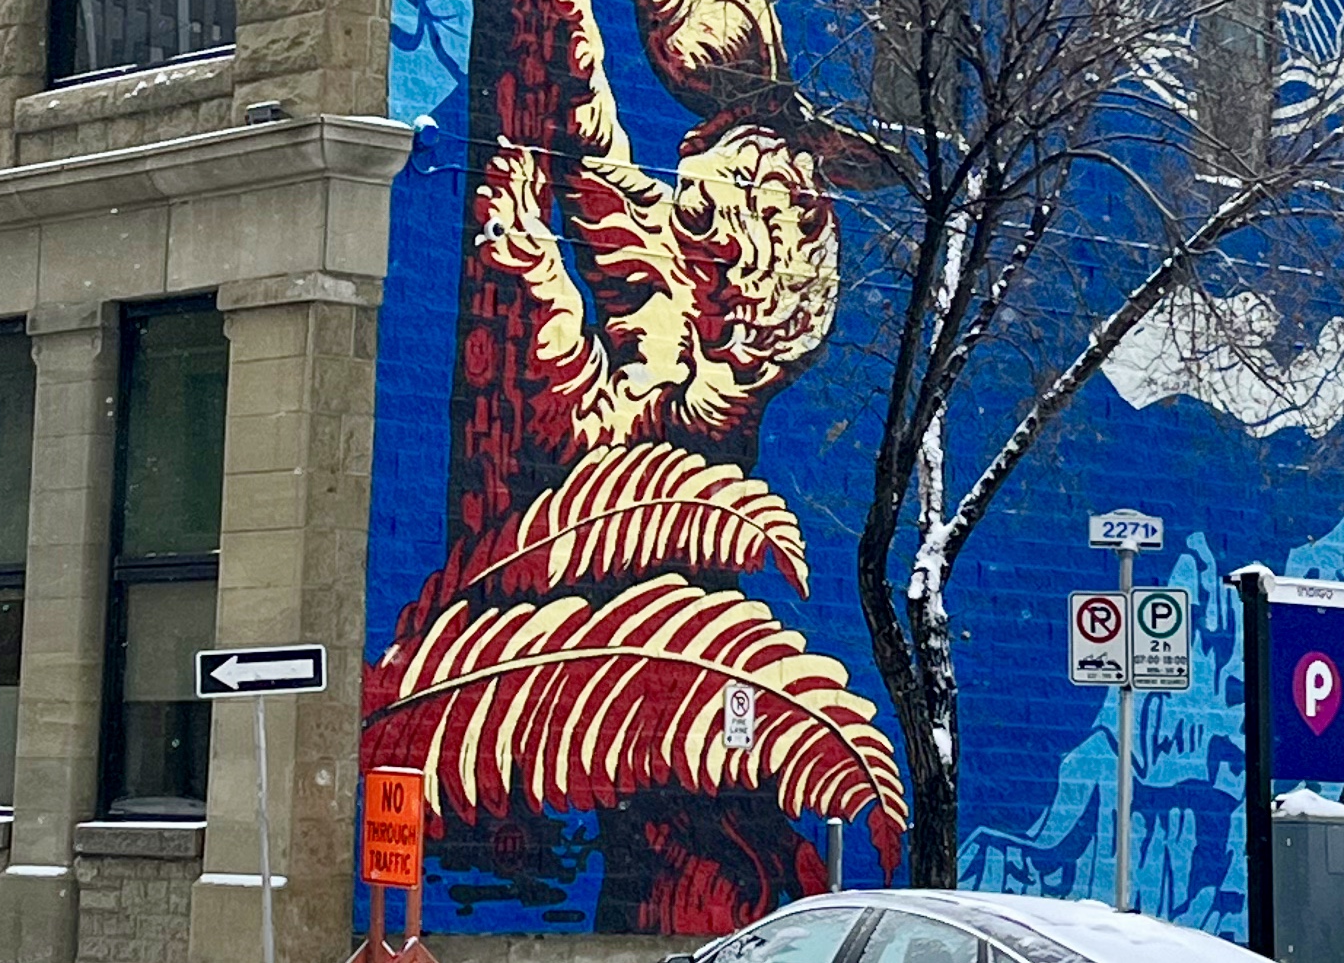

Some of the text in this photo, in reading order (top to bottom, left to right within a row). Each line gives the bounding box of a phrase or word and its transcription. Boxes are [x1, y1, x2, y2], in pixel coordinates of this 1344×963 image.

[1102, 521, 1150, 539] 2271
[1151, 602, 1173, 630] P
[1150, 640, 1172, 653] 2 h
[381, 781, 405, 814] NO
[366, 820, 417, 846] THROUGH
[369, 849, 412, 876] TRAFFIC
